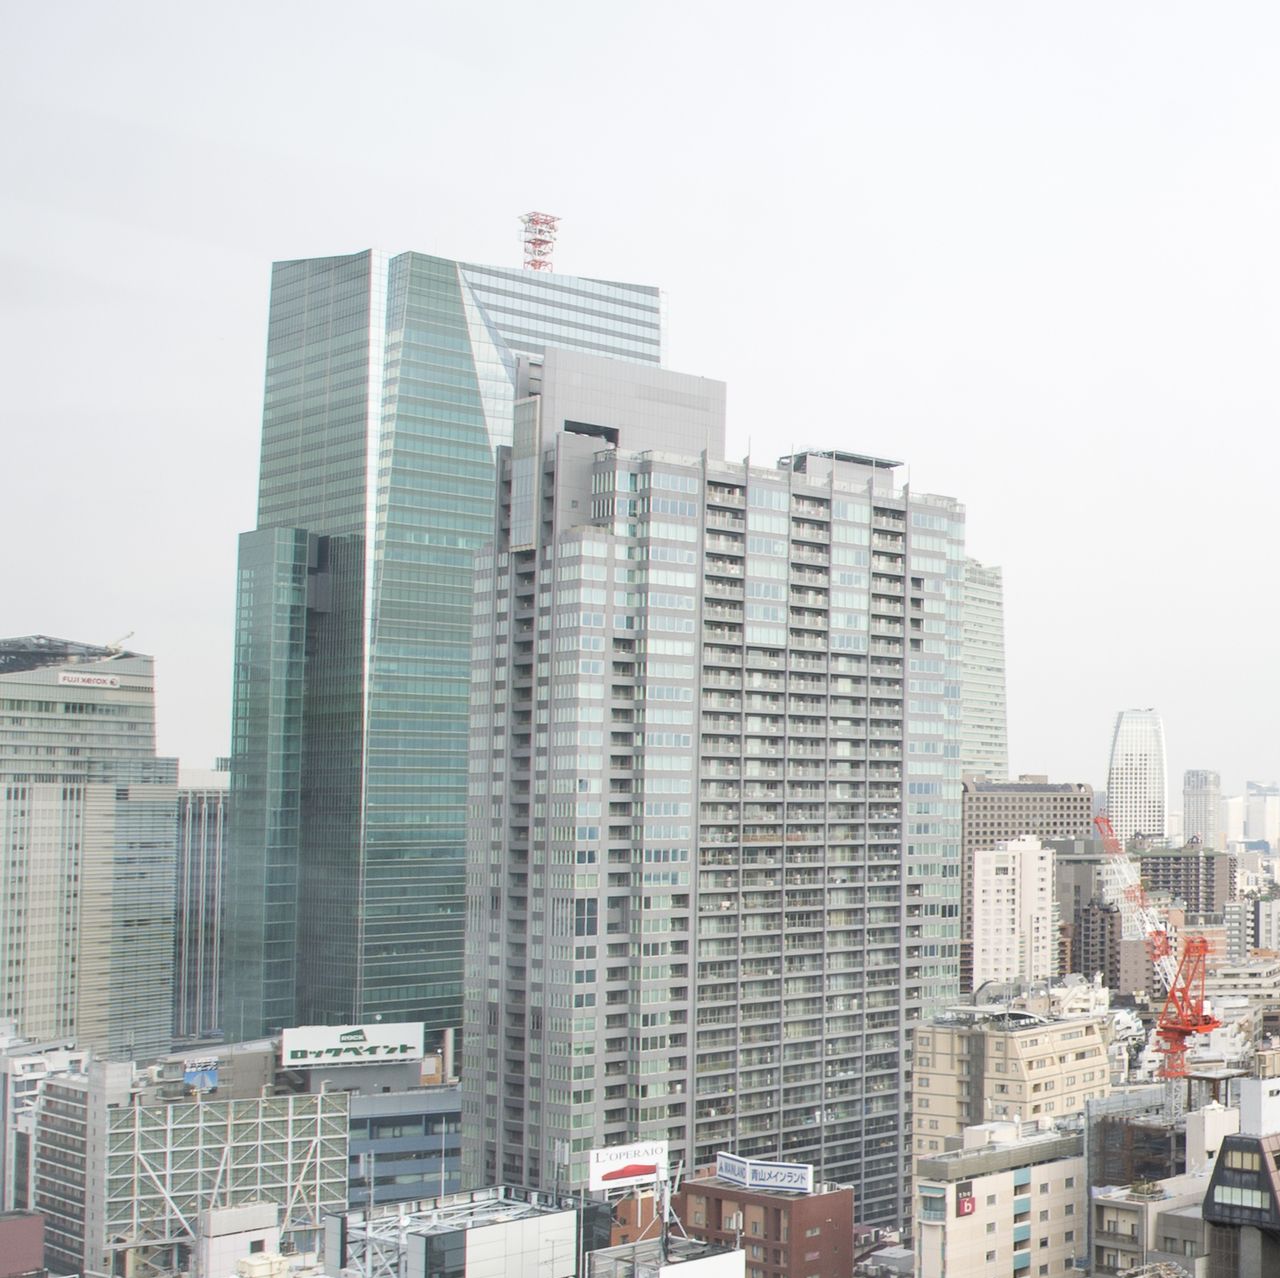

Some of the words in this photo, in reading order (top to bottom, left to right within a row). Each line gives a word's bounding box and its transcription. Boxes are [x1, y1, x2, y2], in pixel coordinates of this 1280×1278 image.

[290, 1044, 416, 1059] ロックペイント
[595, 1147, 664, 1163] L'OPERAIO
[751, 1168, 806, 1184] 青山メインランド
[964, 1198, 973, 1213] b
